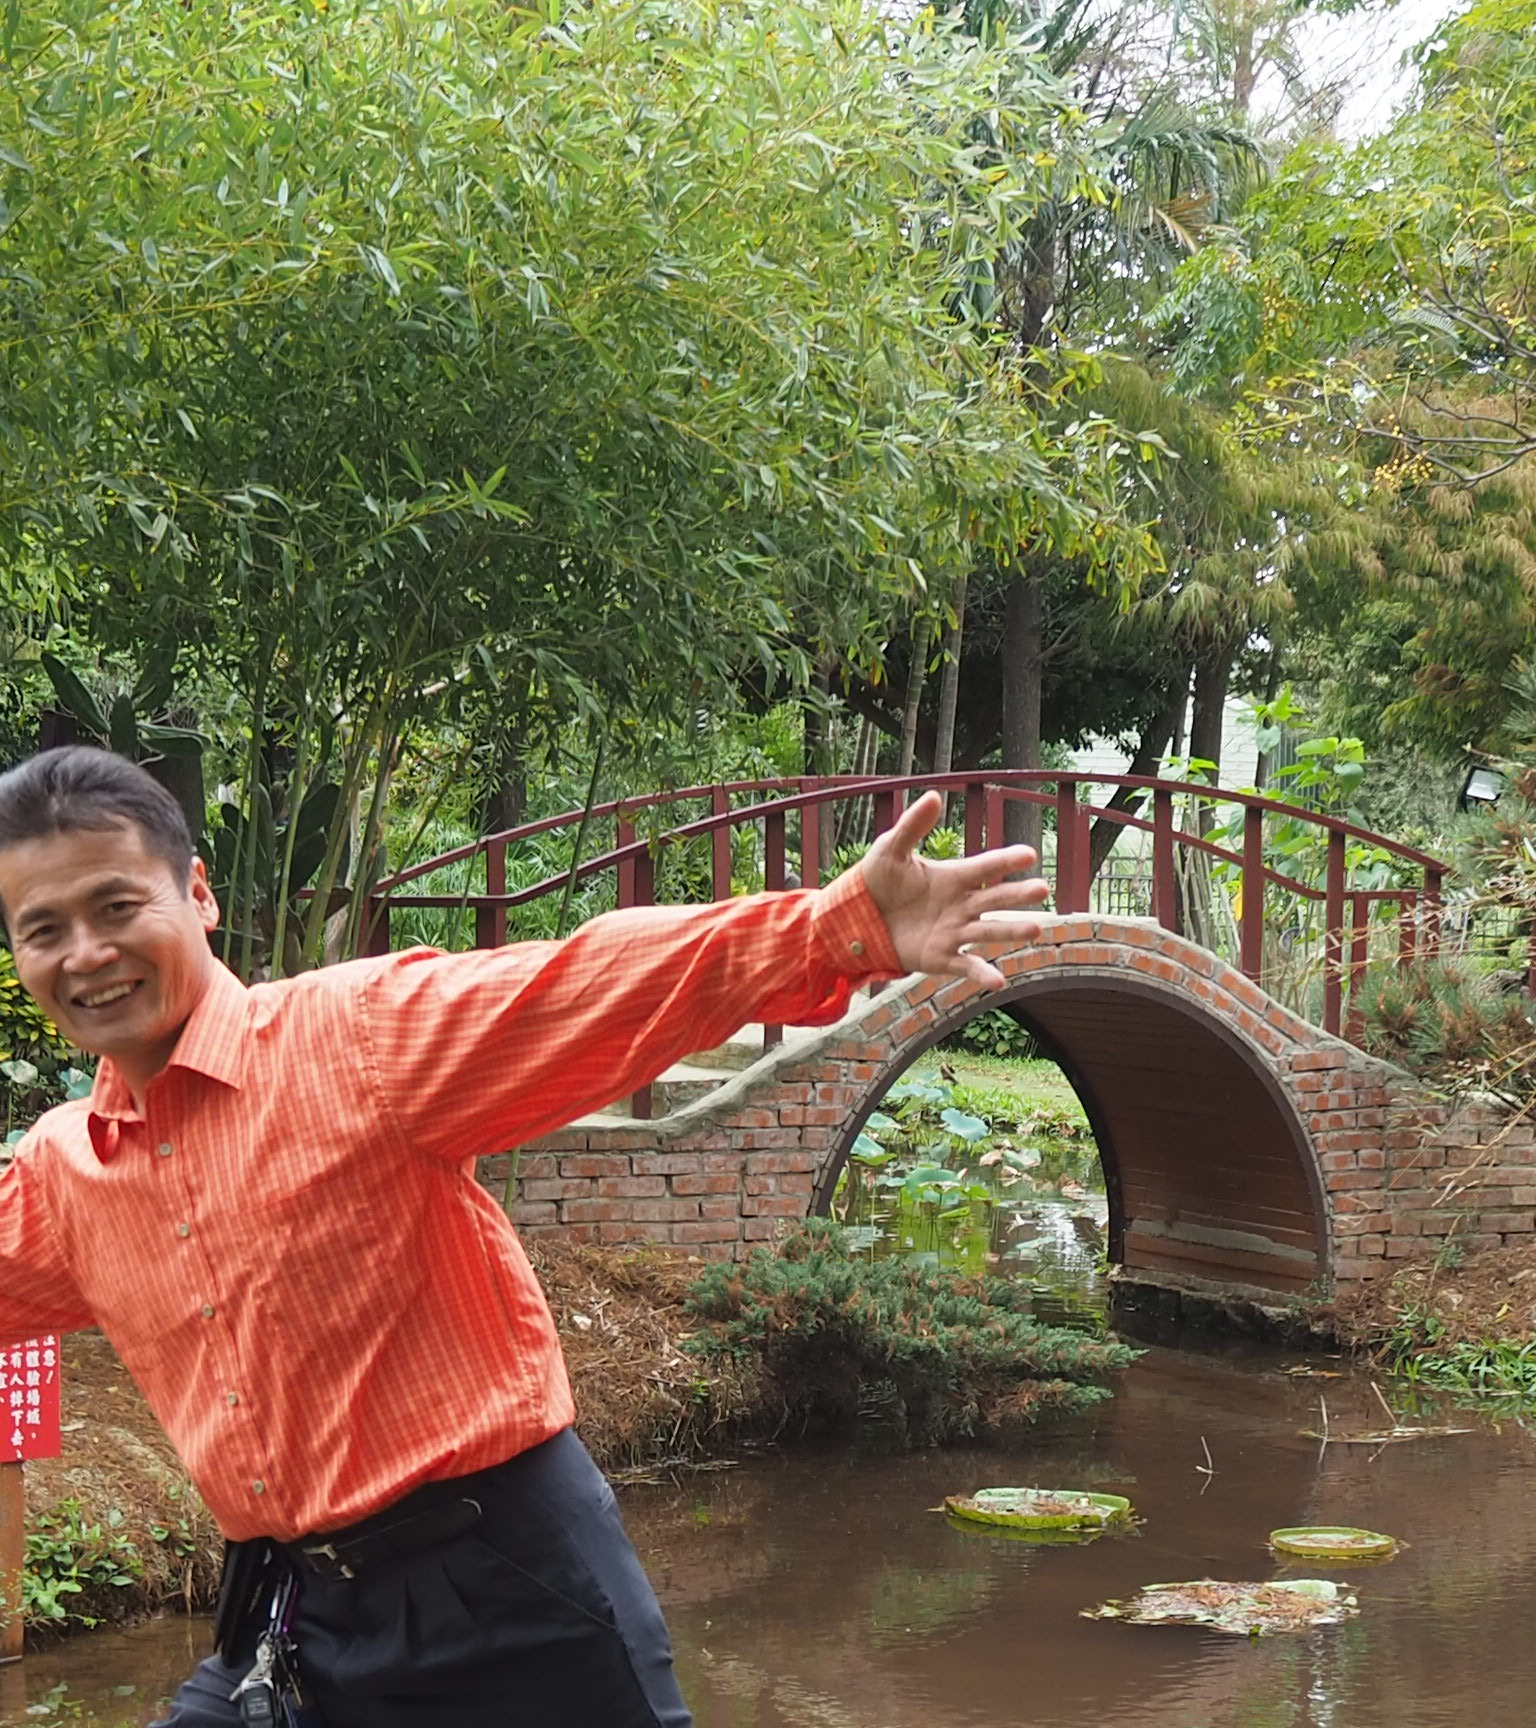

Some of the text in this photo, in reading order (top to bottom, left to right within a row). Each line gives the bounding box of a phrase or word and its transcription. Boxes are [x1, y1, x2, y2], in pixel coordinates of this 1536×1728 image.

[9, 1343, 25, 1459] 有人掉下去、
